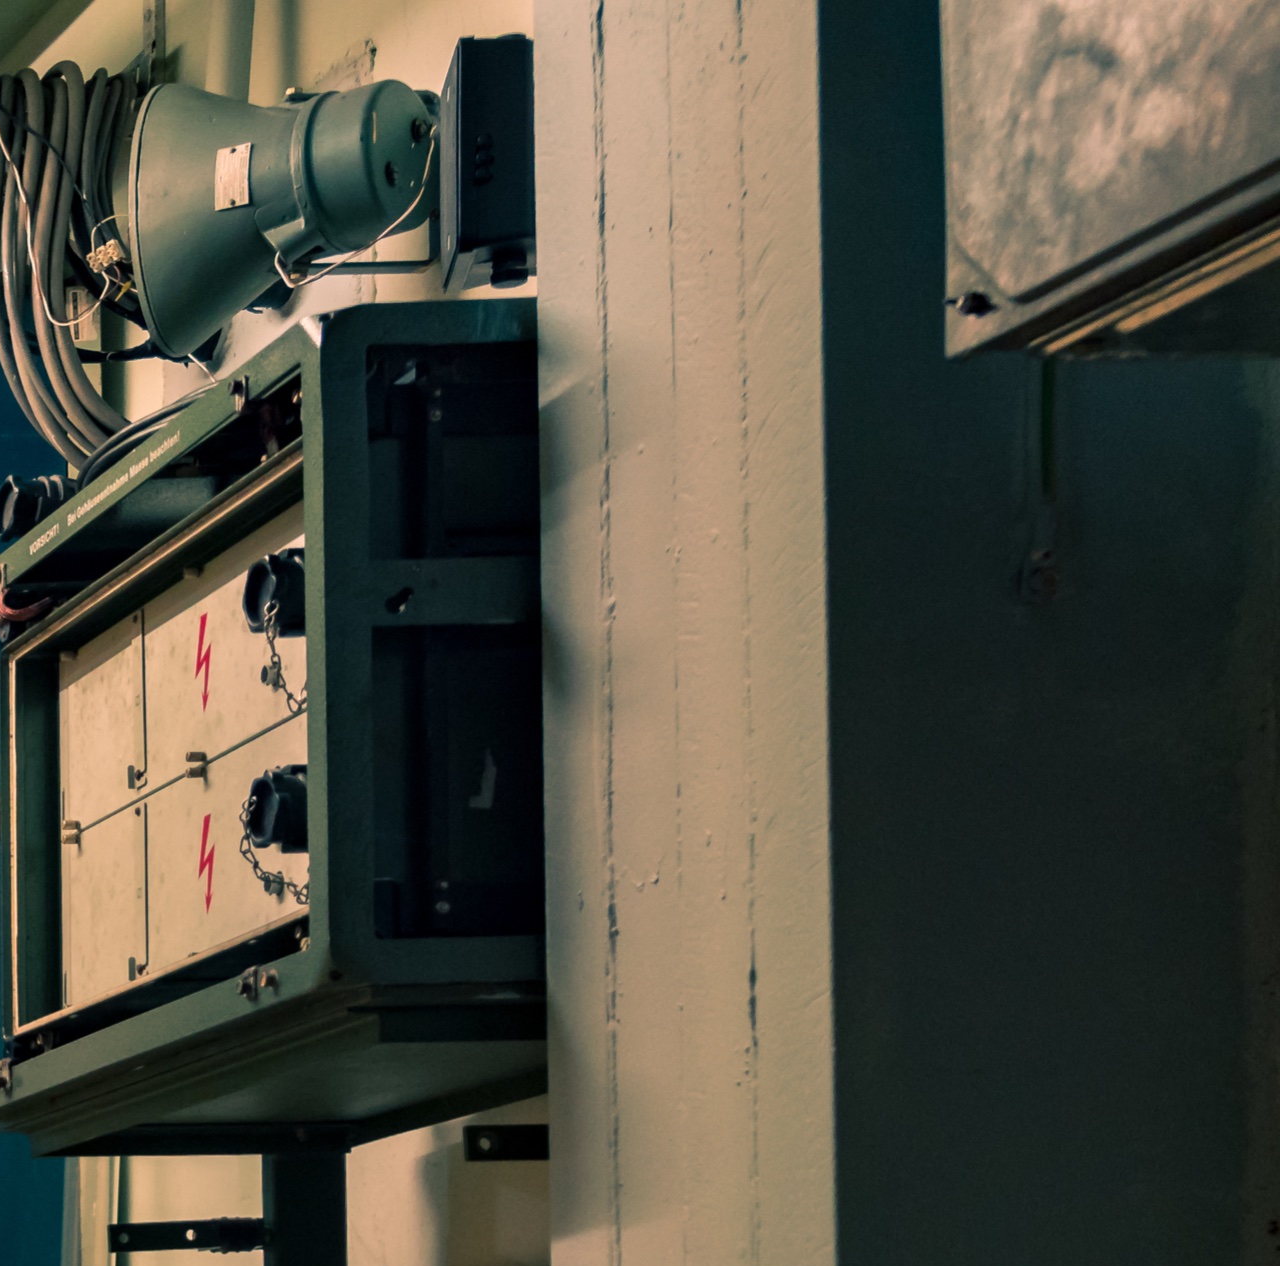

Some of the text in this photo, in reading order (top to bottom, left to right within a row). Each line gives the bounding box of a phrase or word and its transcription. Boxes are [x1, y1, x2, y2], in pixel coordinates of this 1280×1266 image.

[29, 429, 181, 556] VORSICHT! Bei Gehäuseentnahme Masse beachten!
